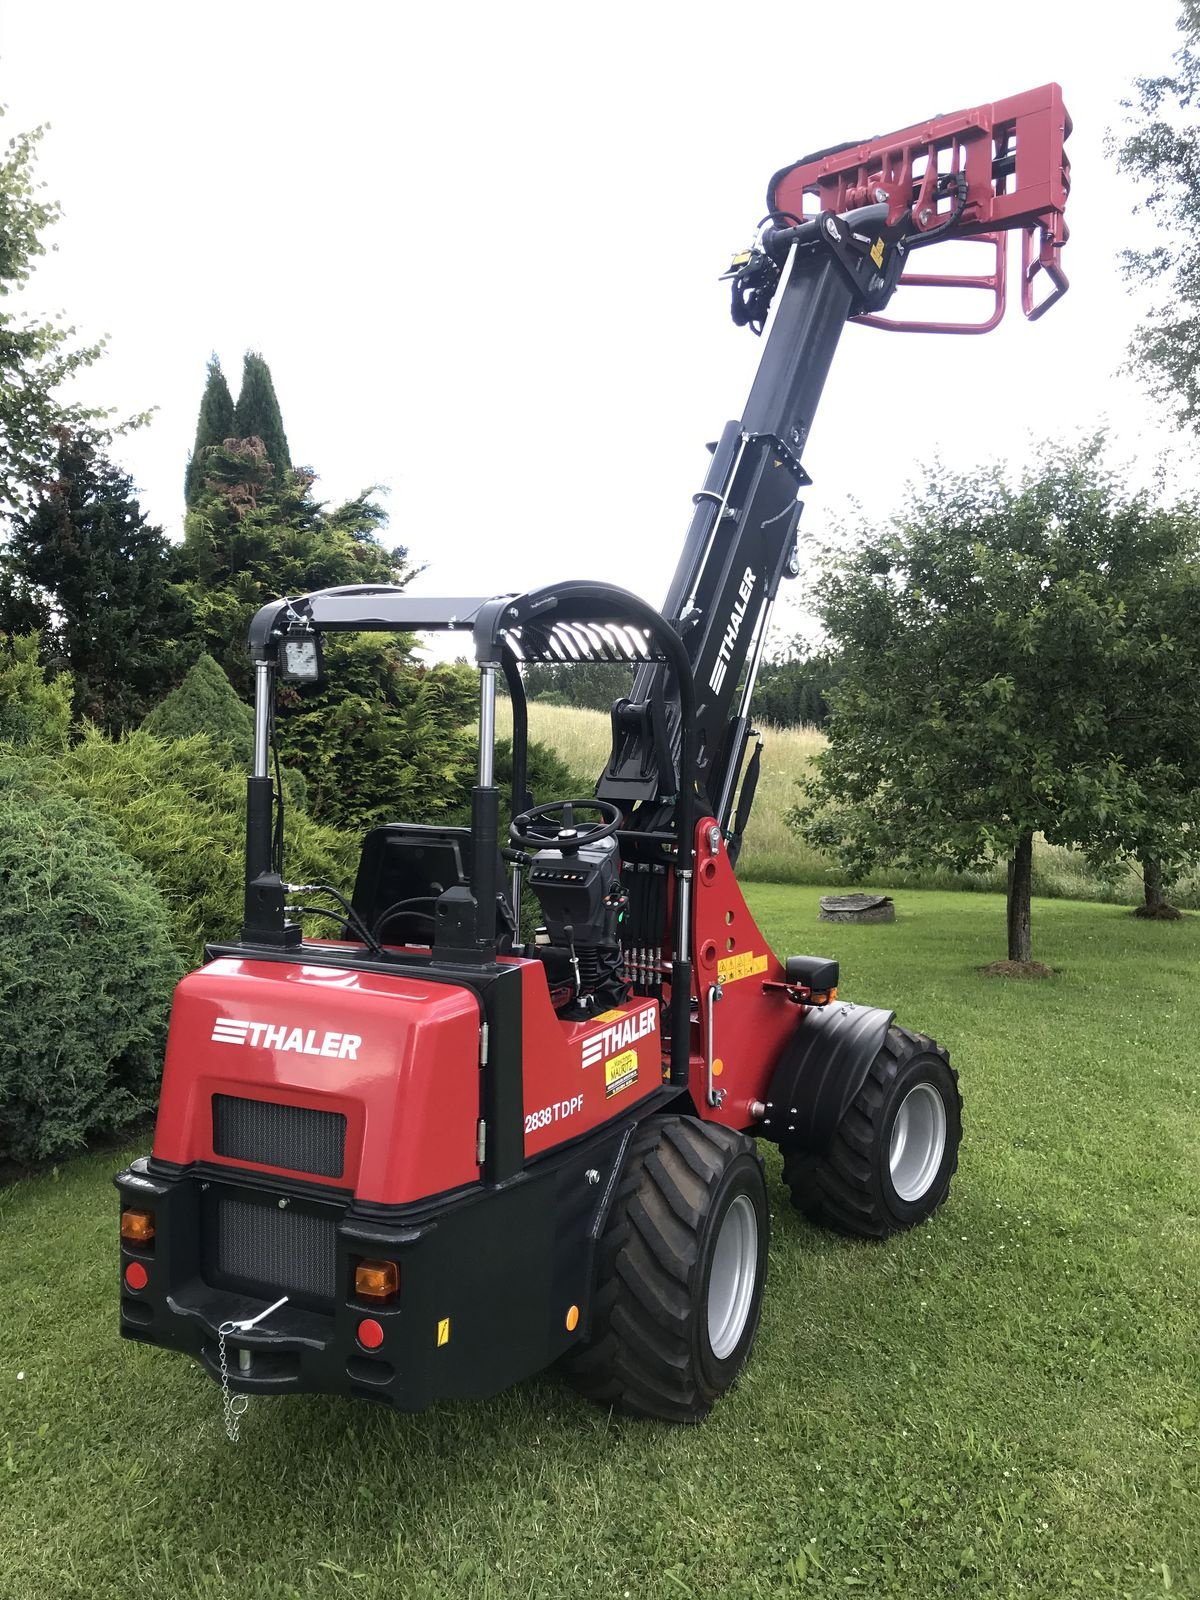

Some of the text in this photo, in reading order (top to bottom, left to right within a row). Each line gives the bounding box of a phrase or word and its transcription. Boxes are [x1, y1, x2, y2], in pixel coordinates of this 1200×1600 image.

[717, 566, 757, 662] THALER
[248, 1021, 362, 1060] THALER
[602, 1006, 656, 1057] THALER
